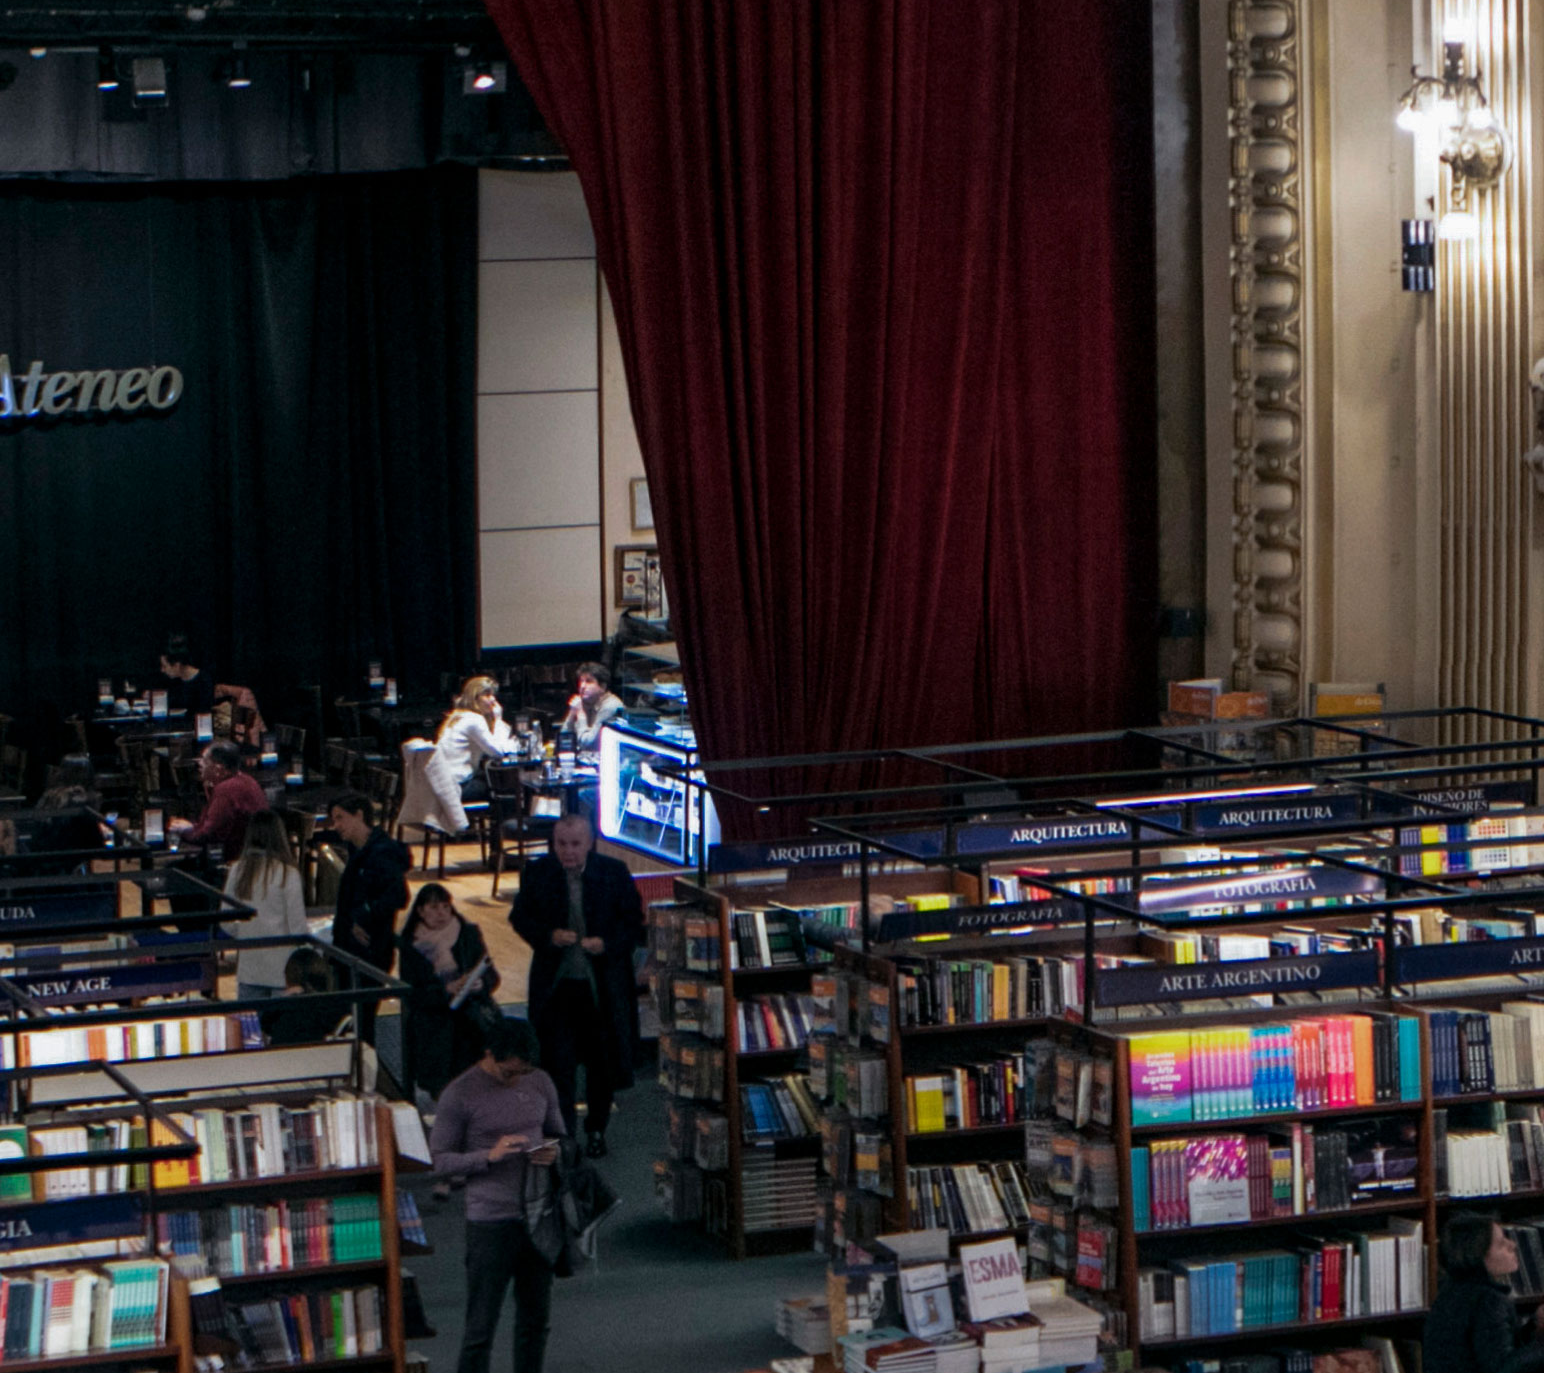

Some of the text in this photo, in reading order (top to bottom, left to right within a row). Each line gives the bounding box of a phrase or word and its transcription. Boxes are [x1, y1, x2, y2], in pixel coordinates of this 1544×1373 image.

[1418, 787, 1486, 803] DISEÑO DE
[1218, 805, 1334, 827] ARQUITECTURA
[1010, 822, 1128, 843] ARQUITECTURA
[1213, 877, 1317, 900] FOTOGRAFIA
[957, 907, 1064, 928] FOTOGRAFIA
[27, 976, 111, 999] NEW AGE
[1159, 963, 1322, 993] ARTE ARGENTINO
[969, 1251, 1022, 1284] ESMA
